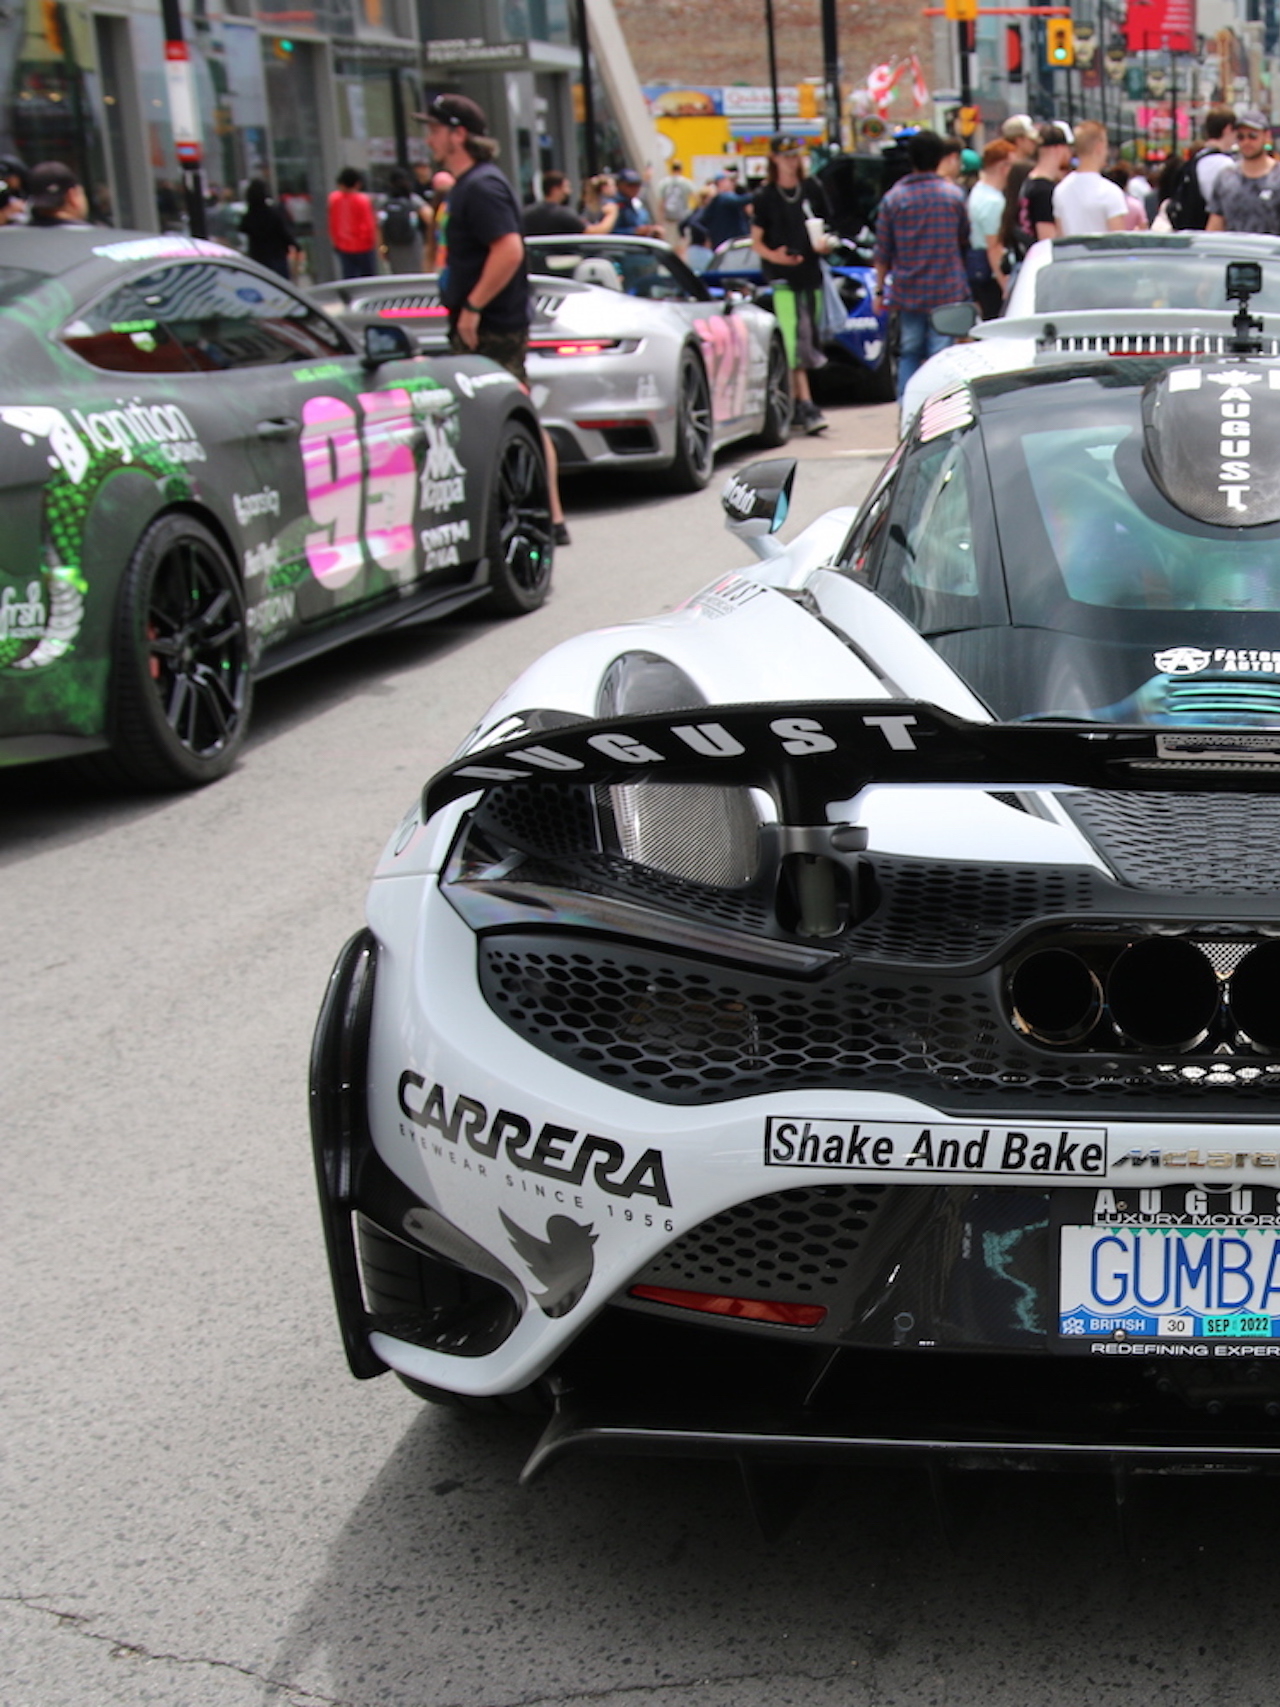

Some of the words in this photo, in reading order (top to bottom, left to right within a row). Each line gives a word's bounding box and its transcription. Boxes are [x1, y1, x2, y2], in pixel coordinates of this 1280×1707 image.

[70, 396, 198, 464] Ignition
[1217, 387, 1252, 512] AUGUST
[452, 715, 918, 783] AUGUST
[397, 1069, 673, 1208] CARRERA
[772, 1123, 893, 1164] Shake
[905, 1129, 990, 1168] And
[1001, 1131, 1103, 1171] Bake
[399, 1123, 488, 1177] EYEWEAR
[505, 1174, 583, 1209] SINCE
[606, 1204, 674, 1232] 1956
[1094, 1213, 1187, 1225] LUXURY
[1090, 1318, 1146, 1332] BRITISH
[1167, 1320, 1186, 1332] 30
[1207, 1319, 1230, 1332] SEP
[1240, 1317, 1268, 1331] 2022
[1091, 1343, 1209, 1356] REDEFINING
